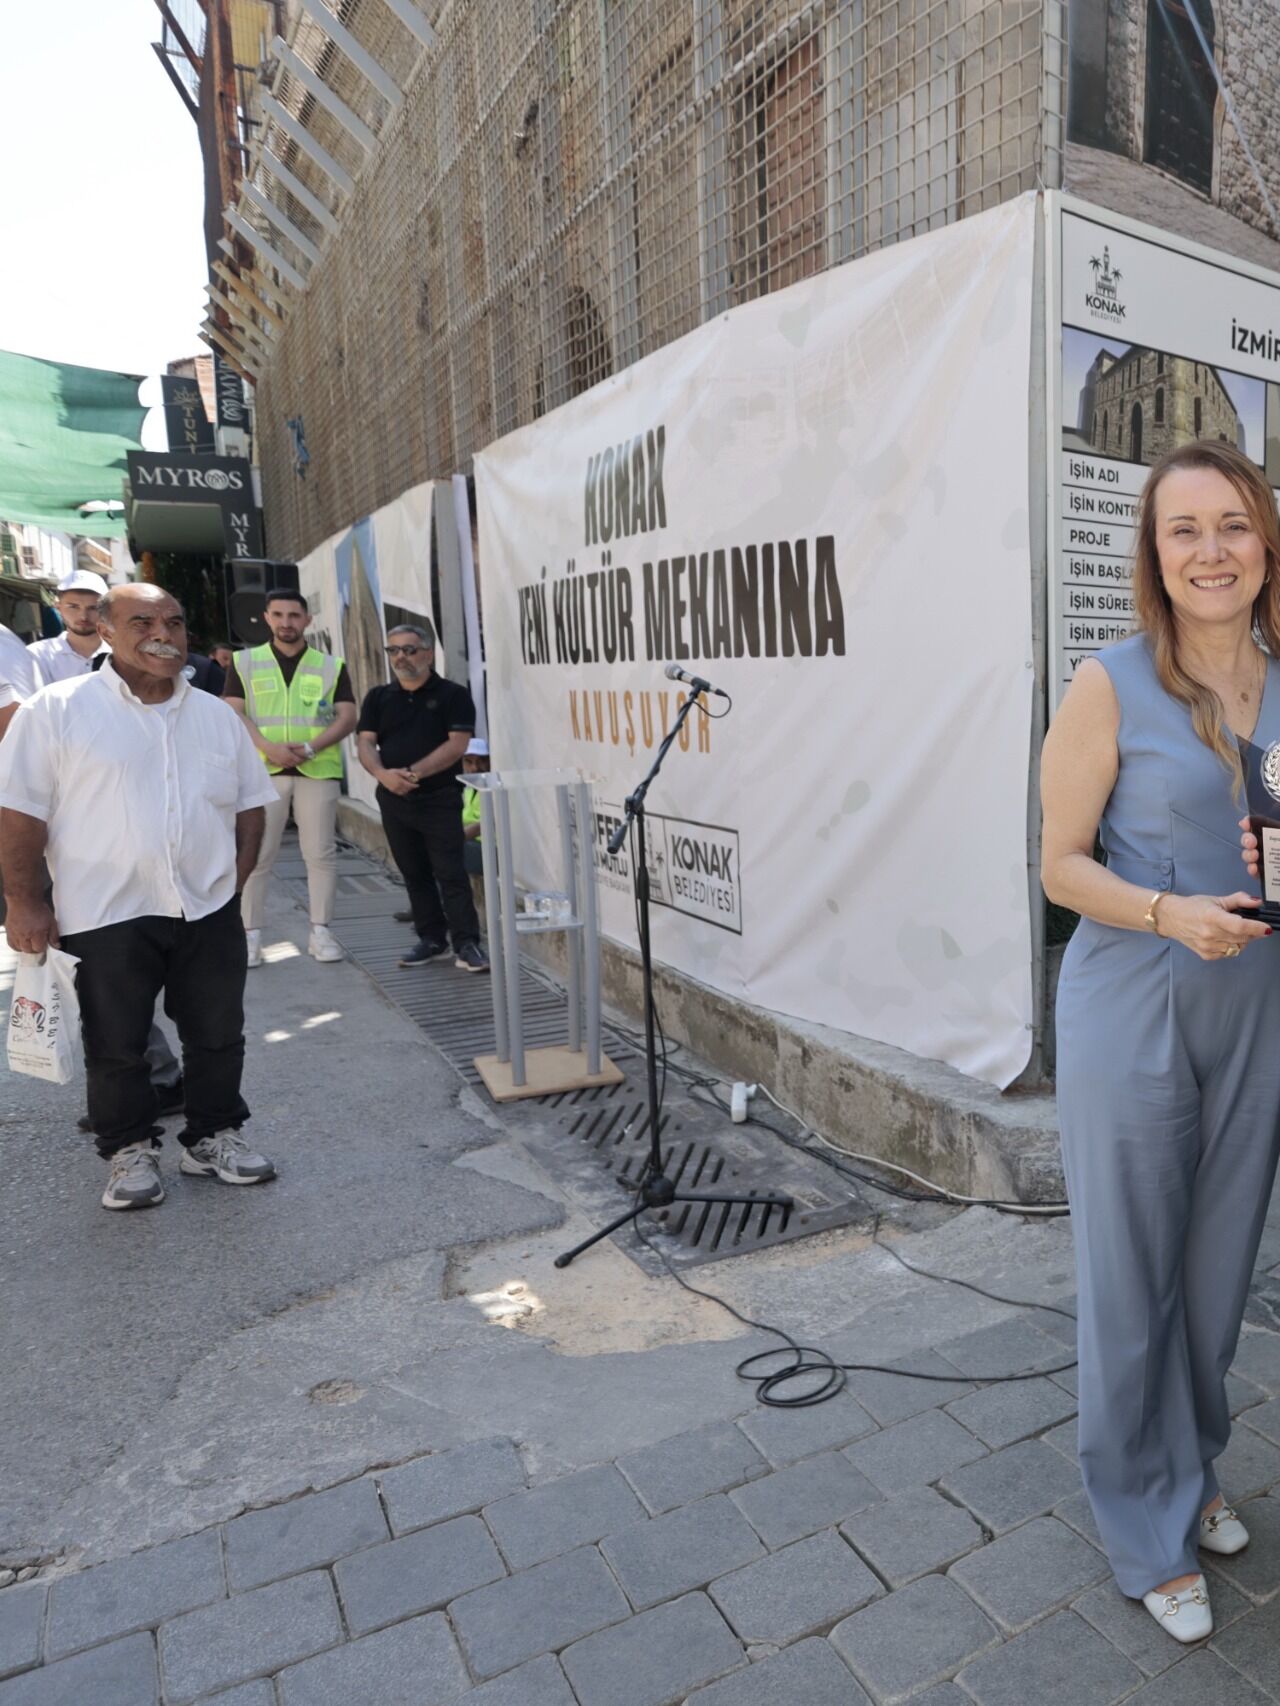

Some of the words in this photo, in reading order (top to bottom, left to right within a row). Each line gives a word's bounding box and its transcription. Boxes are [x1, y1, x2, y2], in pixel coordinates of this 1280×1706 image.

[1086, 293, 1126, 318] KONAK
[137, 465, 244, 491] MYROS
[1070, 458, 1094, 480] İŞİN
[1098, 468, 1119, 484] ADI
[585, 425, 667, 546] KONAK
[1070, 491, 1094, 513] İŞİN
[1098, 500, 1138, 518] KONTR
[231, 512, 250, 557] MYR
[1070, 529, 1110, 547] PROJE
[1070, 557, 1094, 579] İŞİN
[518, 565, 550, 665] YENİ
[553, 550, 635, 665] KÜLTÜR
[642, 535, 846, 662] MEKANINA
[1070, 591, 1094, 612] İŞİN
[1098, 594, 1136, 611] SÜRES
[1070, 623, 1094, 643] İŞİN
[569, 690, 710, 757] KAVUŞUYOR
[671, 834, 733, 884] KONAK
[674, 874, 736, 914] BELEDİYESİ
